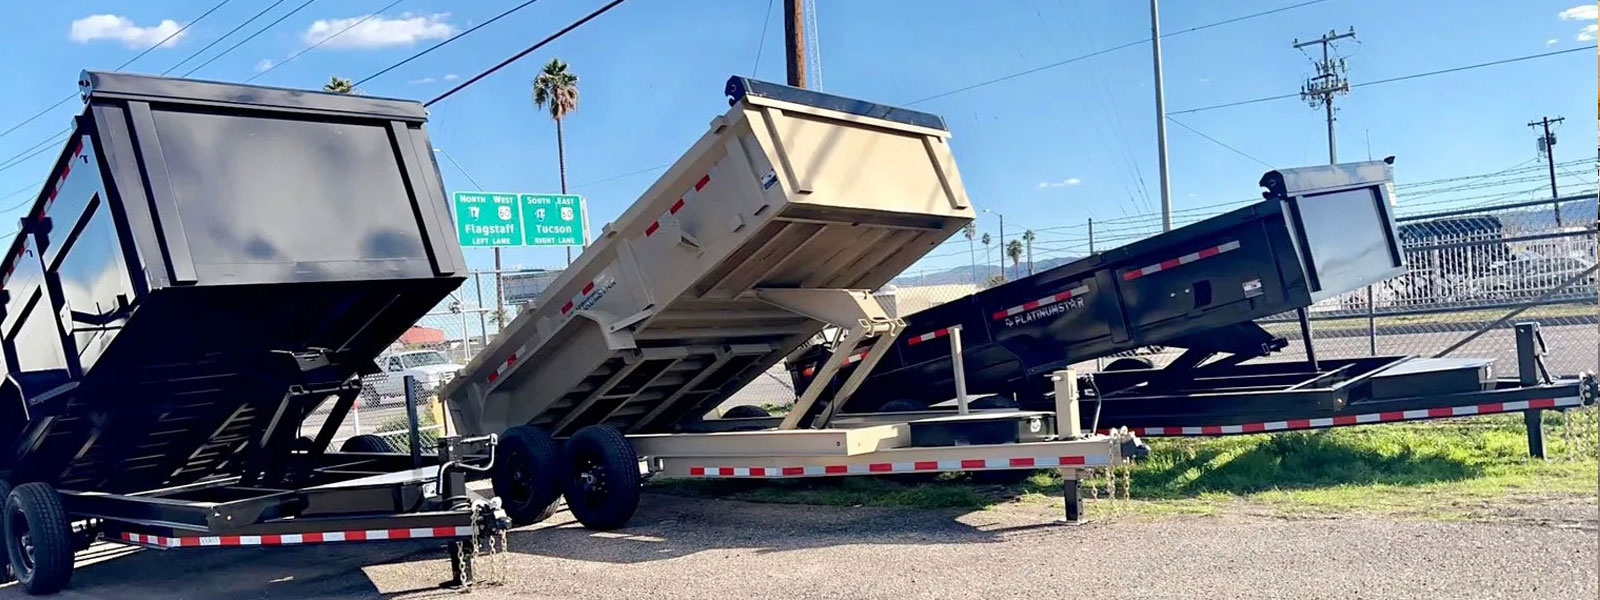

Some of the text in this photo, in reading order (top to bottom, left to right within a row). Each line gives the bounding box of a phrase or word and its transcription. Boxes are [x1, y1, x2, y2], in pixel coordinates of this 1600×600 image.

[460, 195, 513, 204] NORTH WEST
[527, 196, 574, 205] SOUTH EAST
[465, 223, 515, 236] Flagstaff
[536, 225, 573, 234] Tucson
